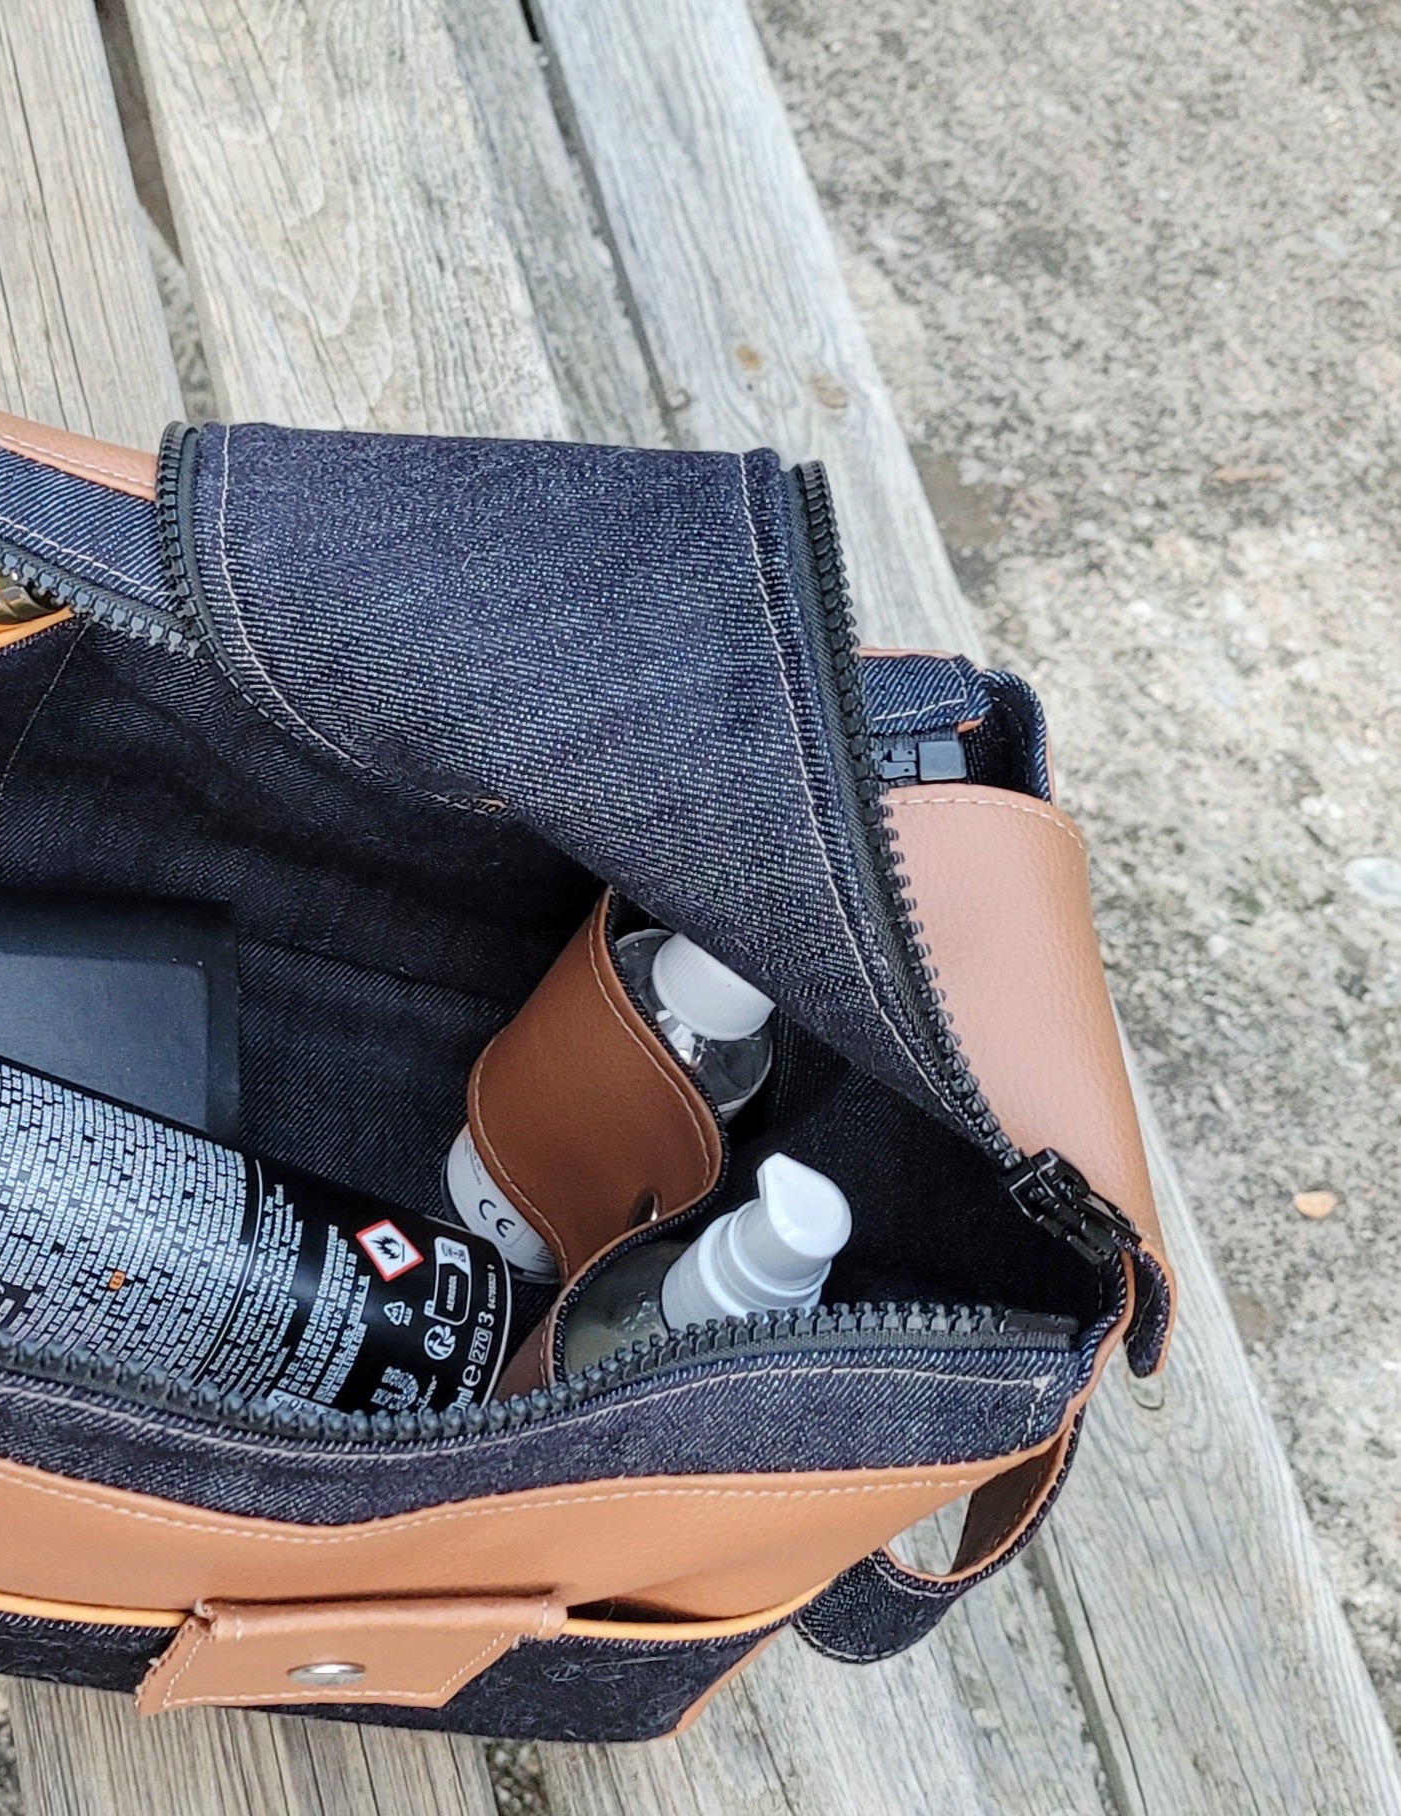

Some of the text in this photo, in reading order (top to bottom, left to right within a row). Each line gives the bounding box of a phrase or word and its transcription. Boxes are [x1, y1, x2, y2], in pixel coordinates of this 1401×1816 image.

[38, 1161, 55, 1190] ZONES
[32, 1191, 46, 1210] DES
[87, 1180, 107, 1220] FLAMMES
[11, 1210, 28, 1235] SANS
[23, 1211, 39, 1236] DANS
[82, 1219, 96, 1238] DES
[89, 1204, 112, 1251] VAPORISER
[181, 1223, 198, 1252] PUEDE
[12, 1244, 39, 1285] VAPORISER
[32, 1220, 48, 1243] VERS
[41, 1202, 55, 1220] LES
[23, 1256, 46, 1289] UTILISER
[39, 1188, 71, 1255] EXCLUSIVEMENT
[53, 1201, 90, 1279] SOUS L'EFFET DE LA
[153, 1237, 171, 1268] EVITAR
[163, 1219, 177, 1239] UNA
[2, 1238, 28, 1282] SEULEMENT
[81, 1253, 96, 1270] PAS
[92, 1288, 104, 1299] NE
[98, 1269, 112, 1287] PAS
[106, 1229, 127, 1268] EXPOSER
[201, 1248, 214, 1263] NO
[76, 1271, 88, 1283] NE
[140, 1303, 157, 1324] USAR
[163, 1247, 180, 1273] COMO
[173, 1230, 185, 1244] SE
[204, 1253, 235, 1316] TEMPERATURAS
[270, 1260, 285, 1282] Peel
[76, 1295, 88, 1307] NE
[82, 1277, 97, 1294] PAS
[109, 1304, 121, 1314] LA
[267, 1297, 297, 1351] Tetramethyl
[402, 1307, 412, 1325] ALU
[477, 1311, 494, 1326] 3
[295, 1340, 309, 1357] AXE
[302, 1297, 325, 1340] RELATION
[470, 1330, 491, 1360] 270
